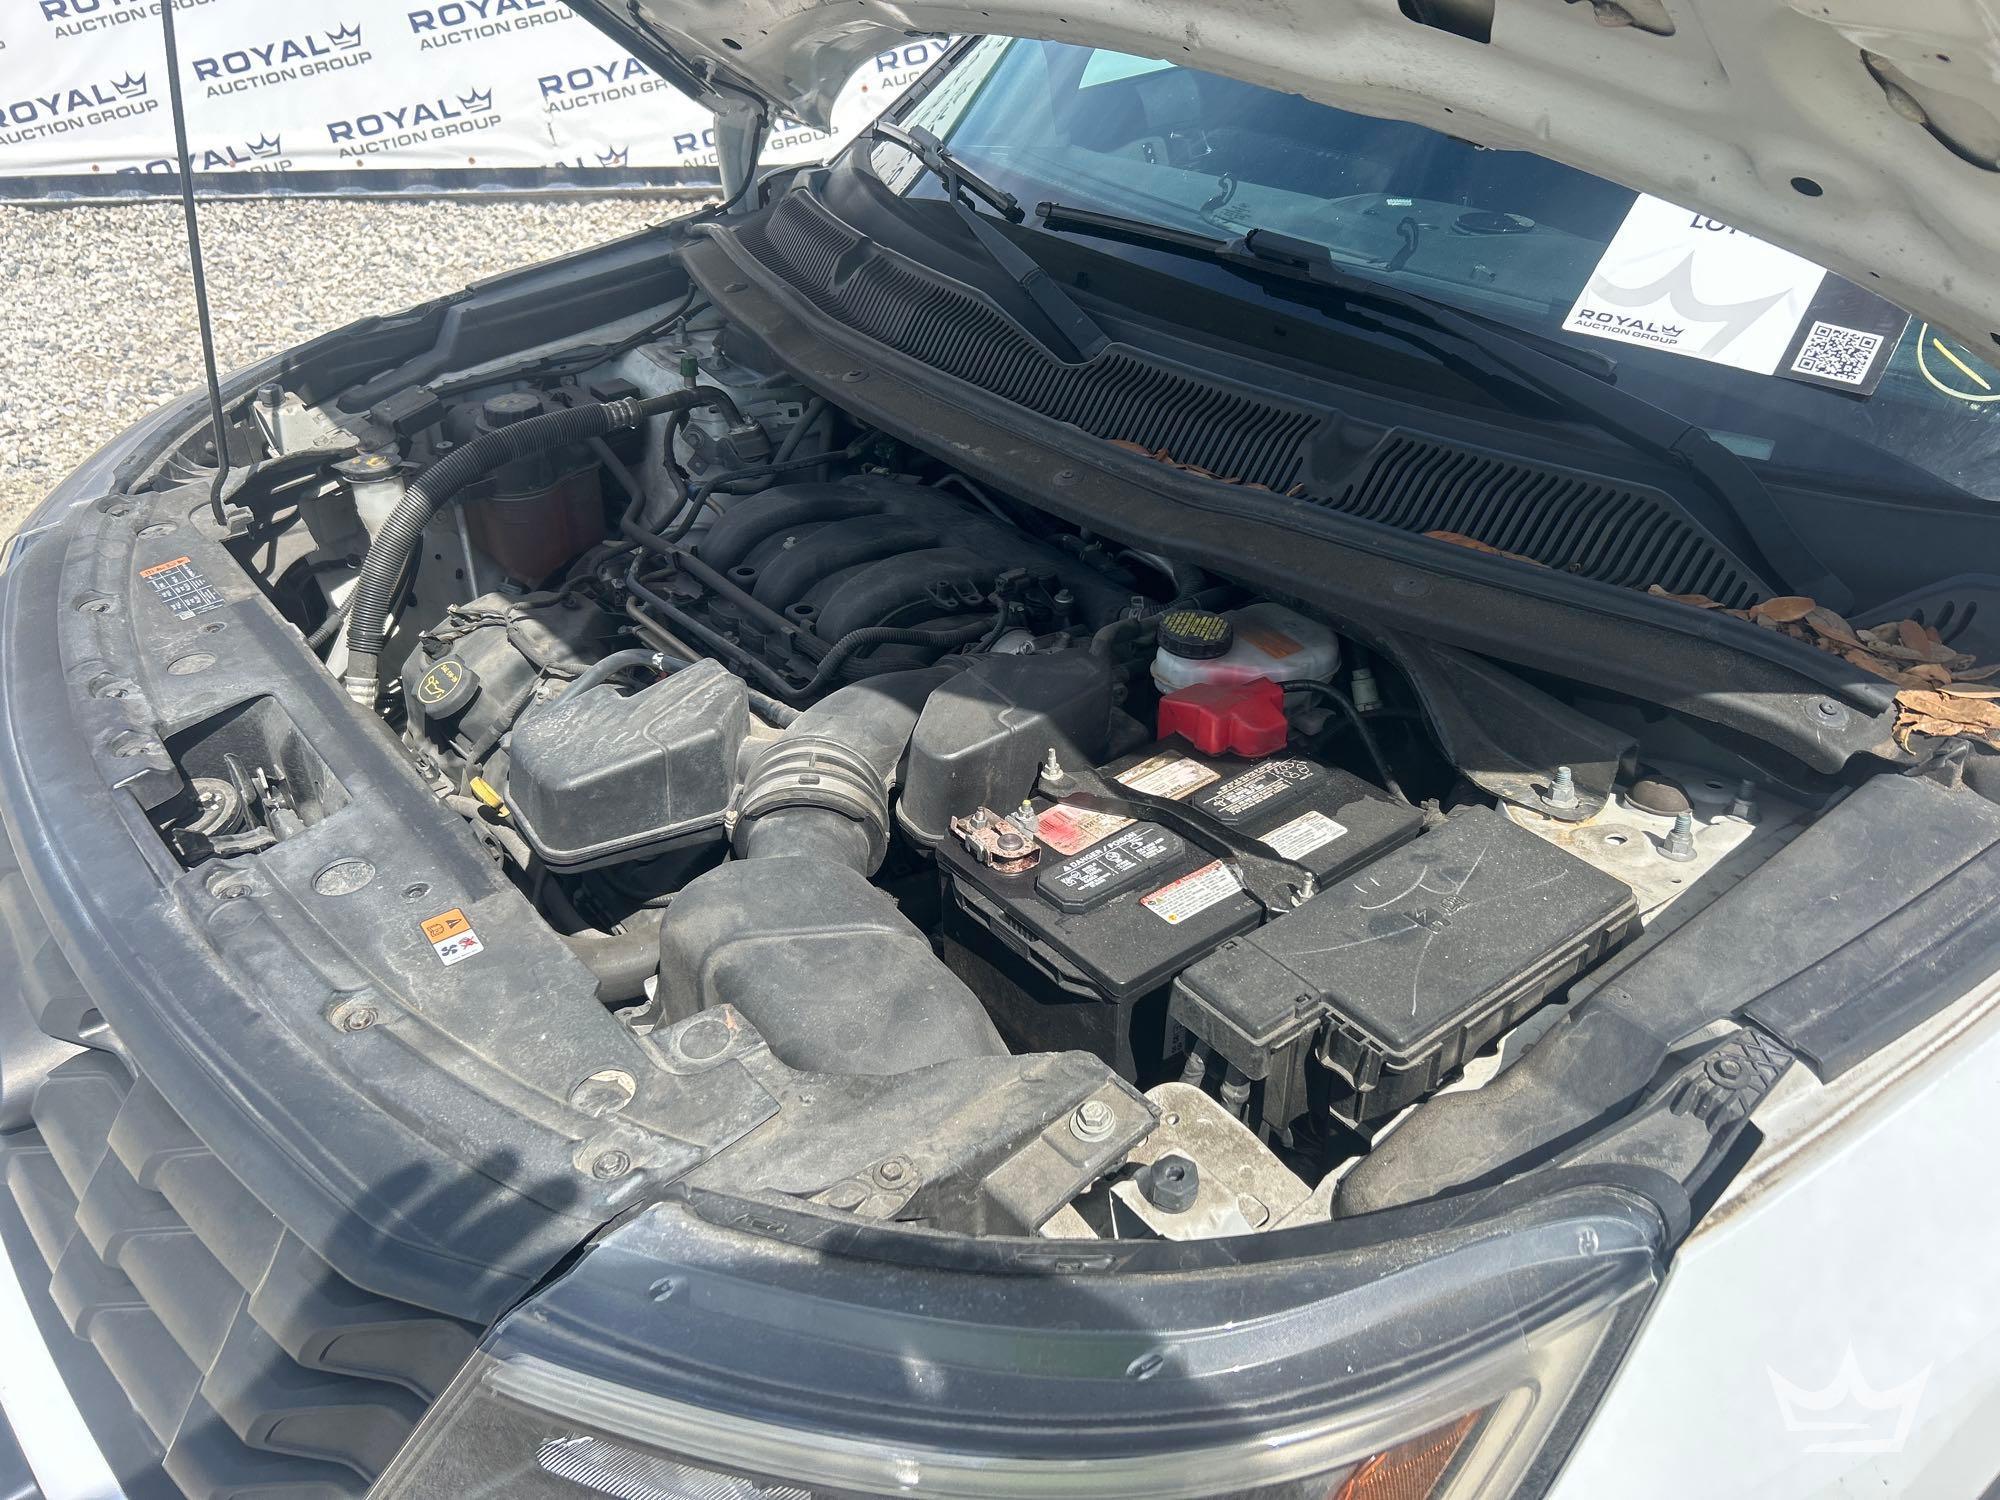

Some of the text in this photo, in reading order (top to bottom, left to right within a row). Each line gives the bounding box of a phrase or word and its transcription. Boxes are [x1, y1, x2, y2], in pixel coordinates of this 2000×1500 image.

[55, 7, 147, 39] AUCTION
[420, 8, 574, 51] AUCTION GROU
[192, 35, 331, 82] ROYAL
[206, 51, 373, 99] AUCTION GROUP
[537, 57, 650, 99] ROYA
[87, 99, 159, 126] GROUP
[548, 84, 637, 114] AUCTION
[326, 98, 462, 144] ROYAL
[339, 114, 503, 159] AUCTION GROUP
[1574, 320, 1678, 345] AUCTION GROUP
[1578, 308, 1659, 333] ROYAL
[1069, 849, 1104, 868] DANGER
[1106, 831, 1138, 849] POISON
